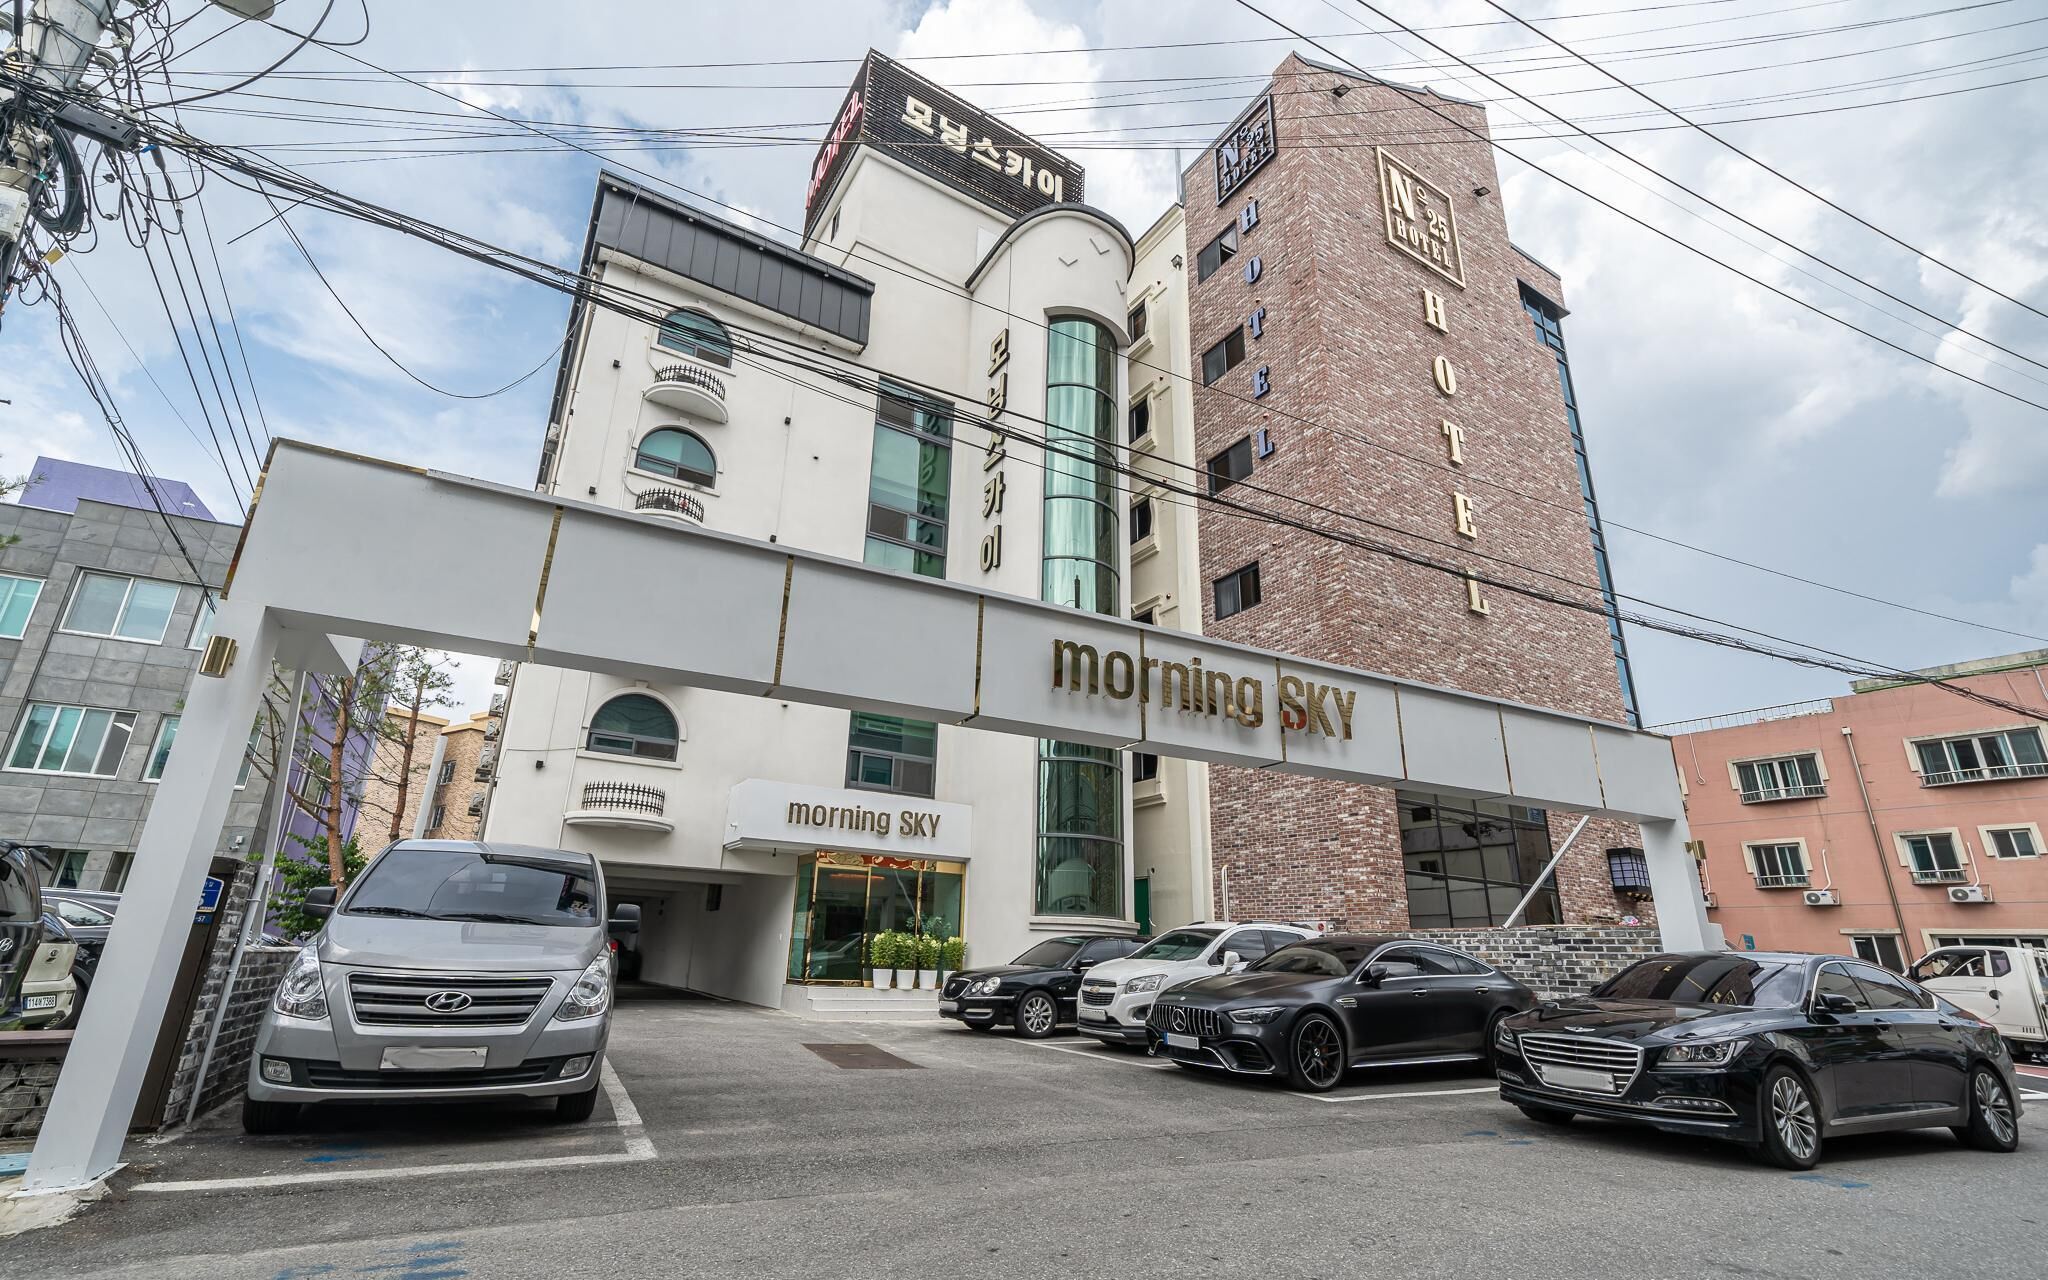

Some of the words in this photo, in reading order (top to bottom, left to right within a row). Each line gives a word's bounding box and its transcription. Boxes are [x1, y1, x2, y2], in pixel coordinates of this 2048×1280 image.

[901, 95, 1063, 204] 모닝스카이
[1223, 142, 1268, 190] HOTEL
[1394, 215, 1453, 268] HOTEL
[1427, 208, 1450, 243] 25
[1240, 200, 1275, 461] HOTEL
[980, 328, 1010, 572] 모닝스카이
[1422, 287, 1490, 616] HOTEL
[1052, 638, 1264, 729] morning
[1278, 675, 1357, 740] SKY
[787, 801, 891, 836] morning
[899, 810, 942, 838] SKY
